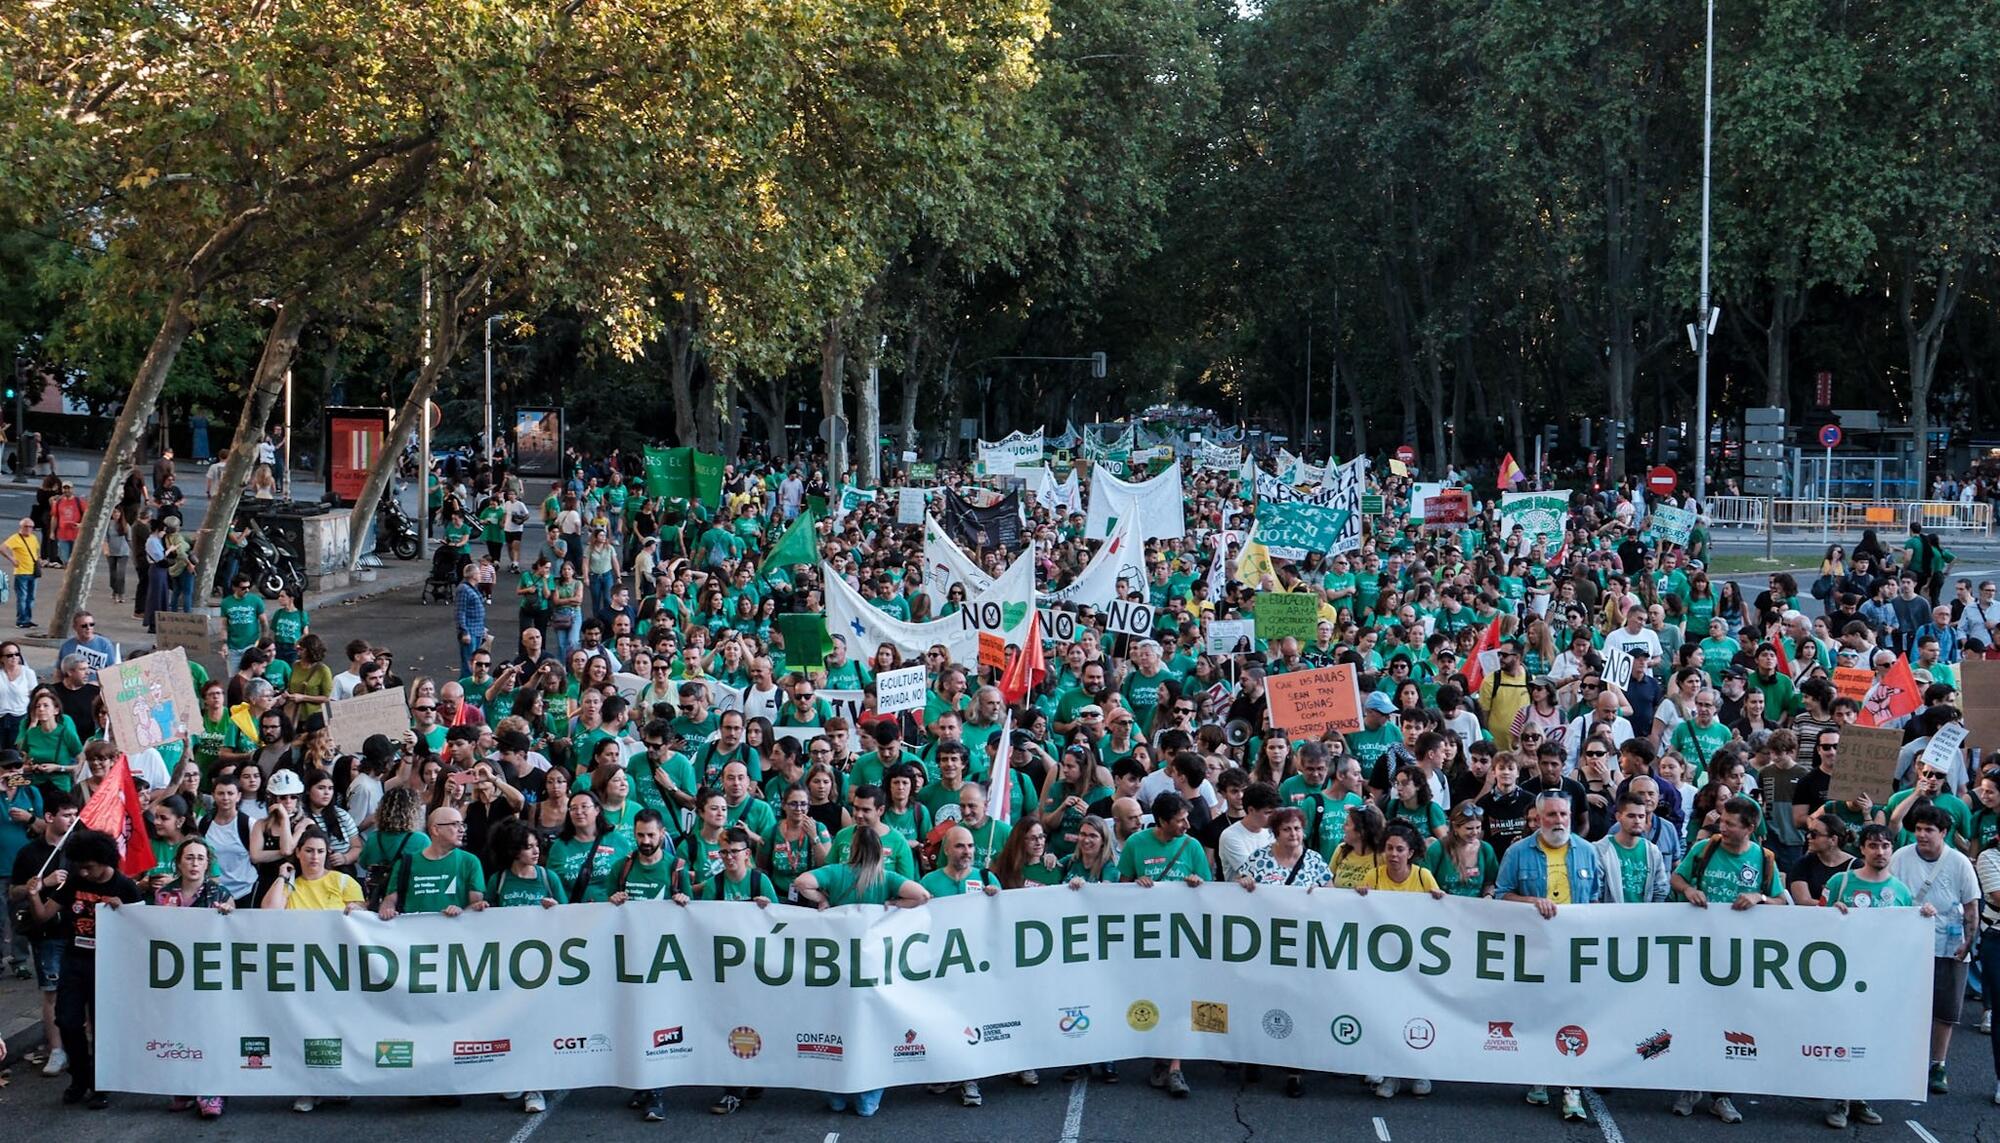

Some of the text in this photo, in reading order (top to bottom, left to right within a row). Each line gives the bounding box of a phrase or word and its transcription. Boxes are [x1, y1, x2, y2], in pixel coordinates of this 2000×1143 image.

[1104, 461, 1122, 474] NO
[961, 602, 1001, 630] NO
[1108, 601, 1151, 634] NO
[1038, 610, 1074, 640] NO
[76, 647, 107, 669] STA!
[1603, 649, 1631, 687] NO
[1275, 680, 1292, 690] QUE
[1314, 671, 1346, 683] AULAS
[1288, 687, 1334, 700] SEAN TAN
[1295, 698, 1333, 712] DIGNAS
[1302, 711, 1326, 719] COMO
[149, 912, 1868, 994] DEFENDEMOS LA PÚBLICA. DEFENDEMOS EL FUTURO.
[1065, 1009, 1083, 1017] TEA
[983, 1020, 1021, 1031] COORDINADORA
[657, 1030, 680, 1043] CNT
[796, 1033, 844, 1045] CONFAPA
[455, 1043, 492, 1053] CCOO
[553, 1037, 587, 1050] CGT
[894, 1044, 926, 1052] CONTRA
[1725, 1045, 1758, 1057] STEM
[1802, 1045, 1832, 1058] UGT
